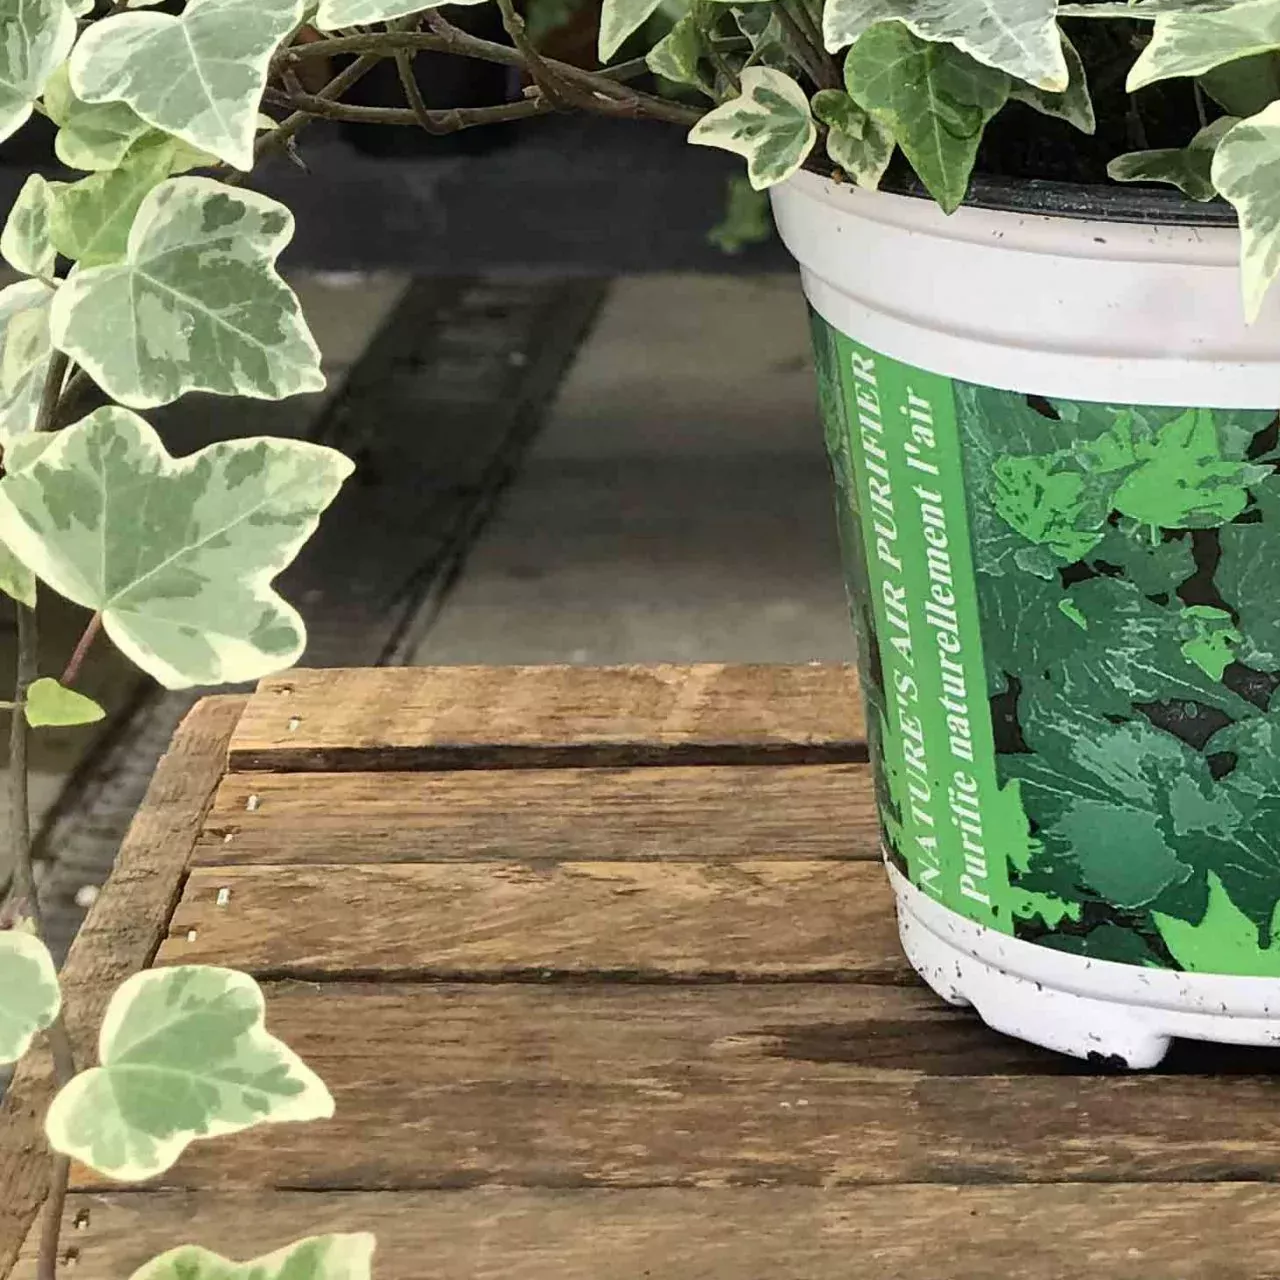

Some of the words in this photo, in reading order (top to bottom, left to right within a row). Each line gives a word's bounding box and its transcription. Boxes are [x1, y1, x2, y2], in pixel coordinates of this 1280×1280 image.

[850, 352, 903, 574] PURIFIER
[899, 385, 941, 476] l'air
[882, 579, 915, 667] AIR
[911, 483, 975, 763] naturellement
[892, 668, 944, 898] NATURE'S
[946, 770, 991, 906] Purifie
